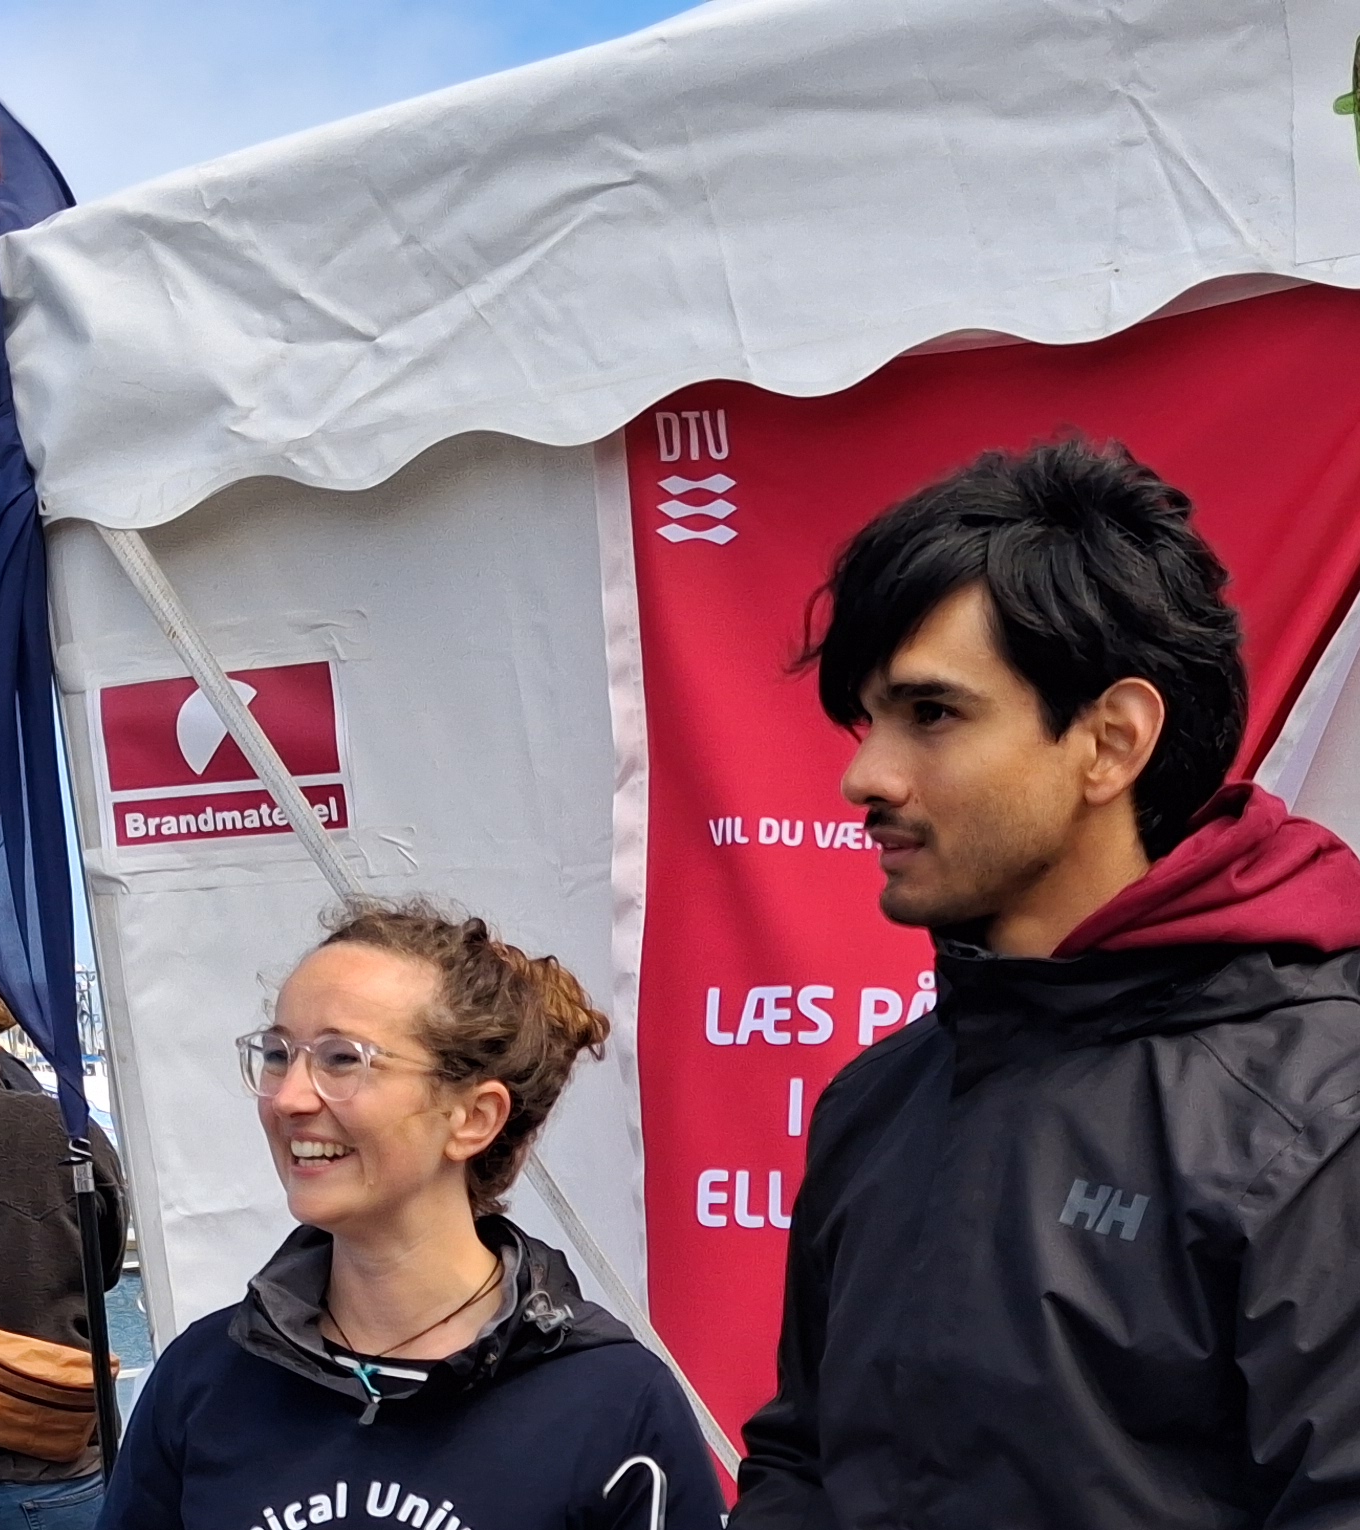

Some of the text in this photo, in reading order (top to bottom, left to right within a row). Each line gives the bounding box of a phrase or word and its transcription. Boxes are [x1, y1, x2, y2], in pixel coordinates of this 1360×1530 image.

[656, 409, 730, 462] DTU
[124, 796, 339, 839] Brandmateel
[708, 815, 881, 851] VIL DU VÆ
[705, 984, 835, 1046] LÆS
[696, 1169, 792, 1229] ELL
[1059, 1178, 1150, 1242] HH
